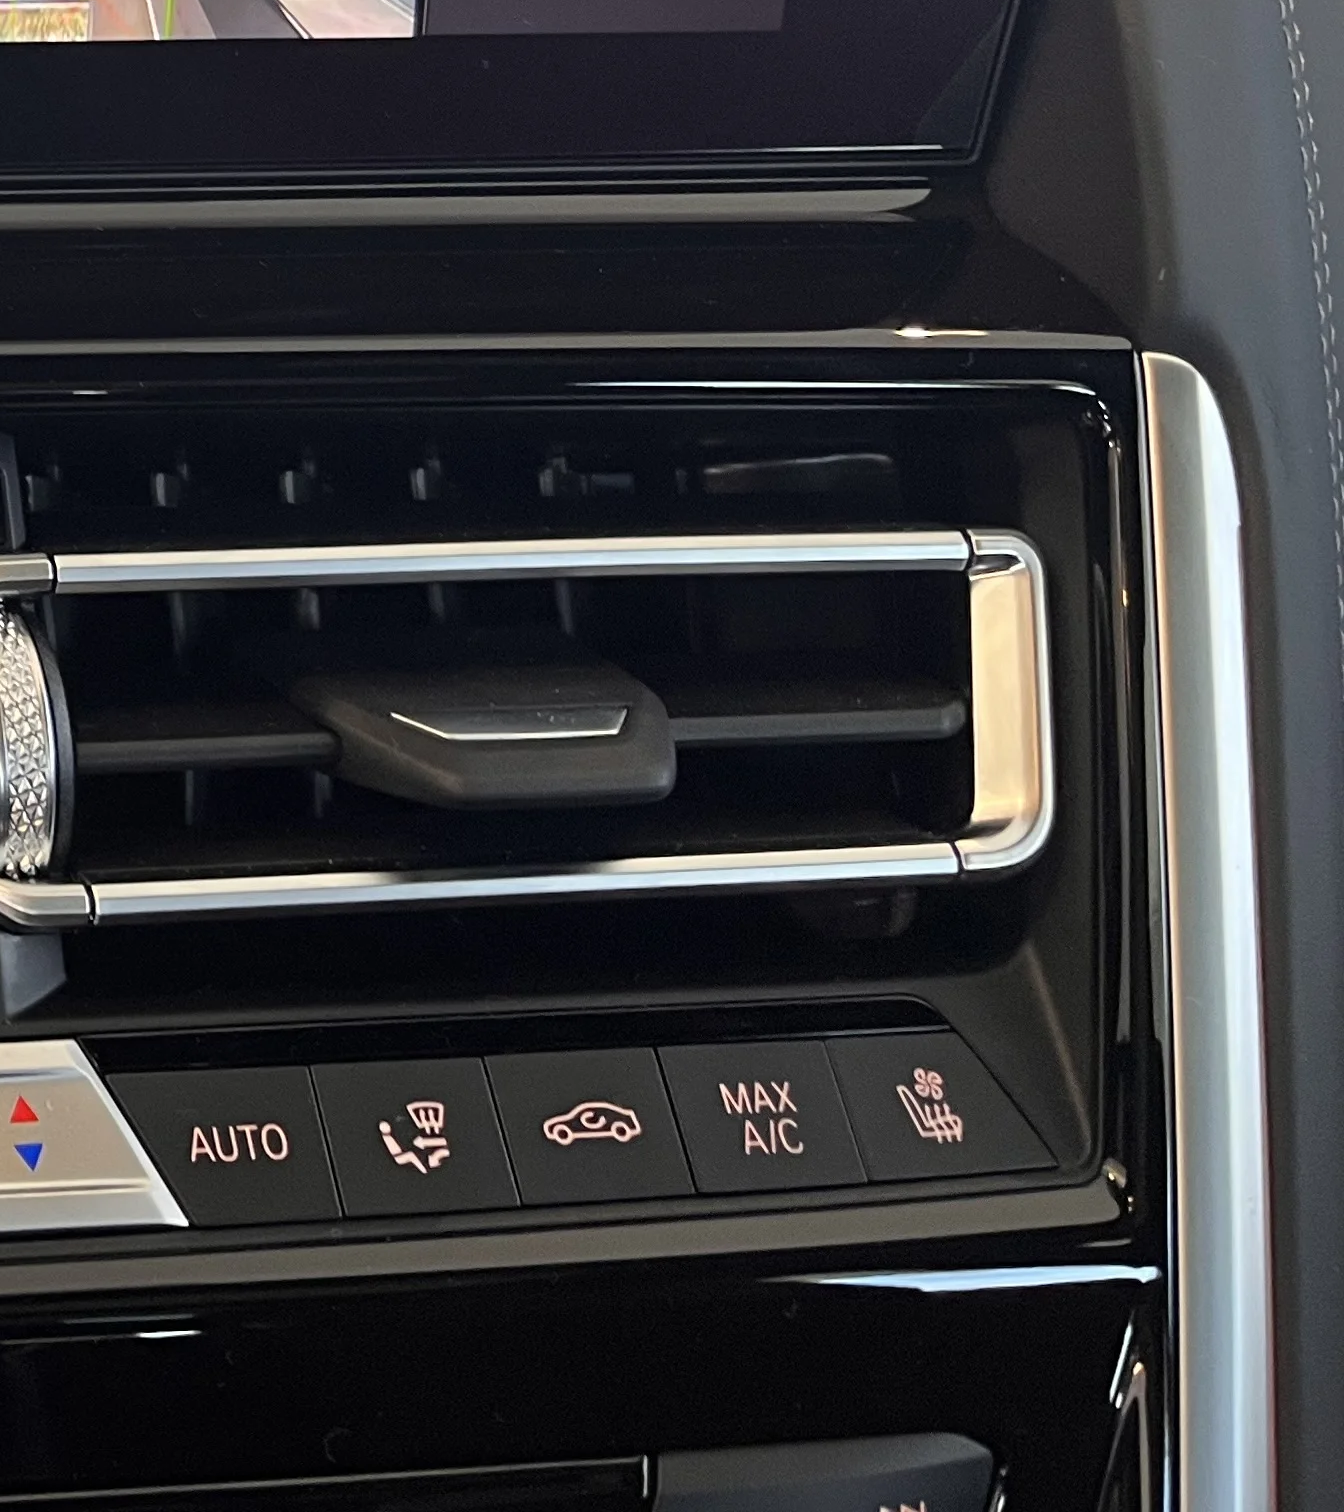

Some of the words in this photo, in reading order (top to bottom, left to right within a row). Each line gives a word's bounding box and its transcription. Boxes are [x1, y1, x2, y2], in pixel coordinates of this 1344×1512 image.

[718, 1081, 799, 1115] MAX
[190, 1123, 289, 1163] AUTO
[743, 1118, 804, 1156] A/C
